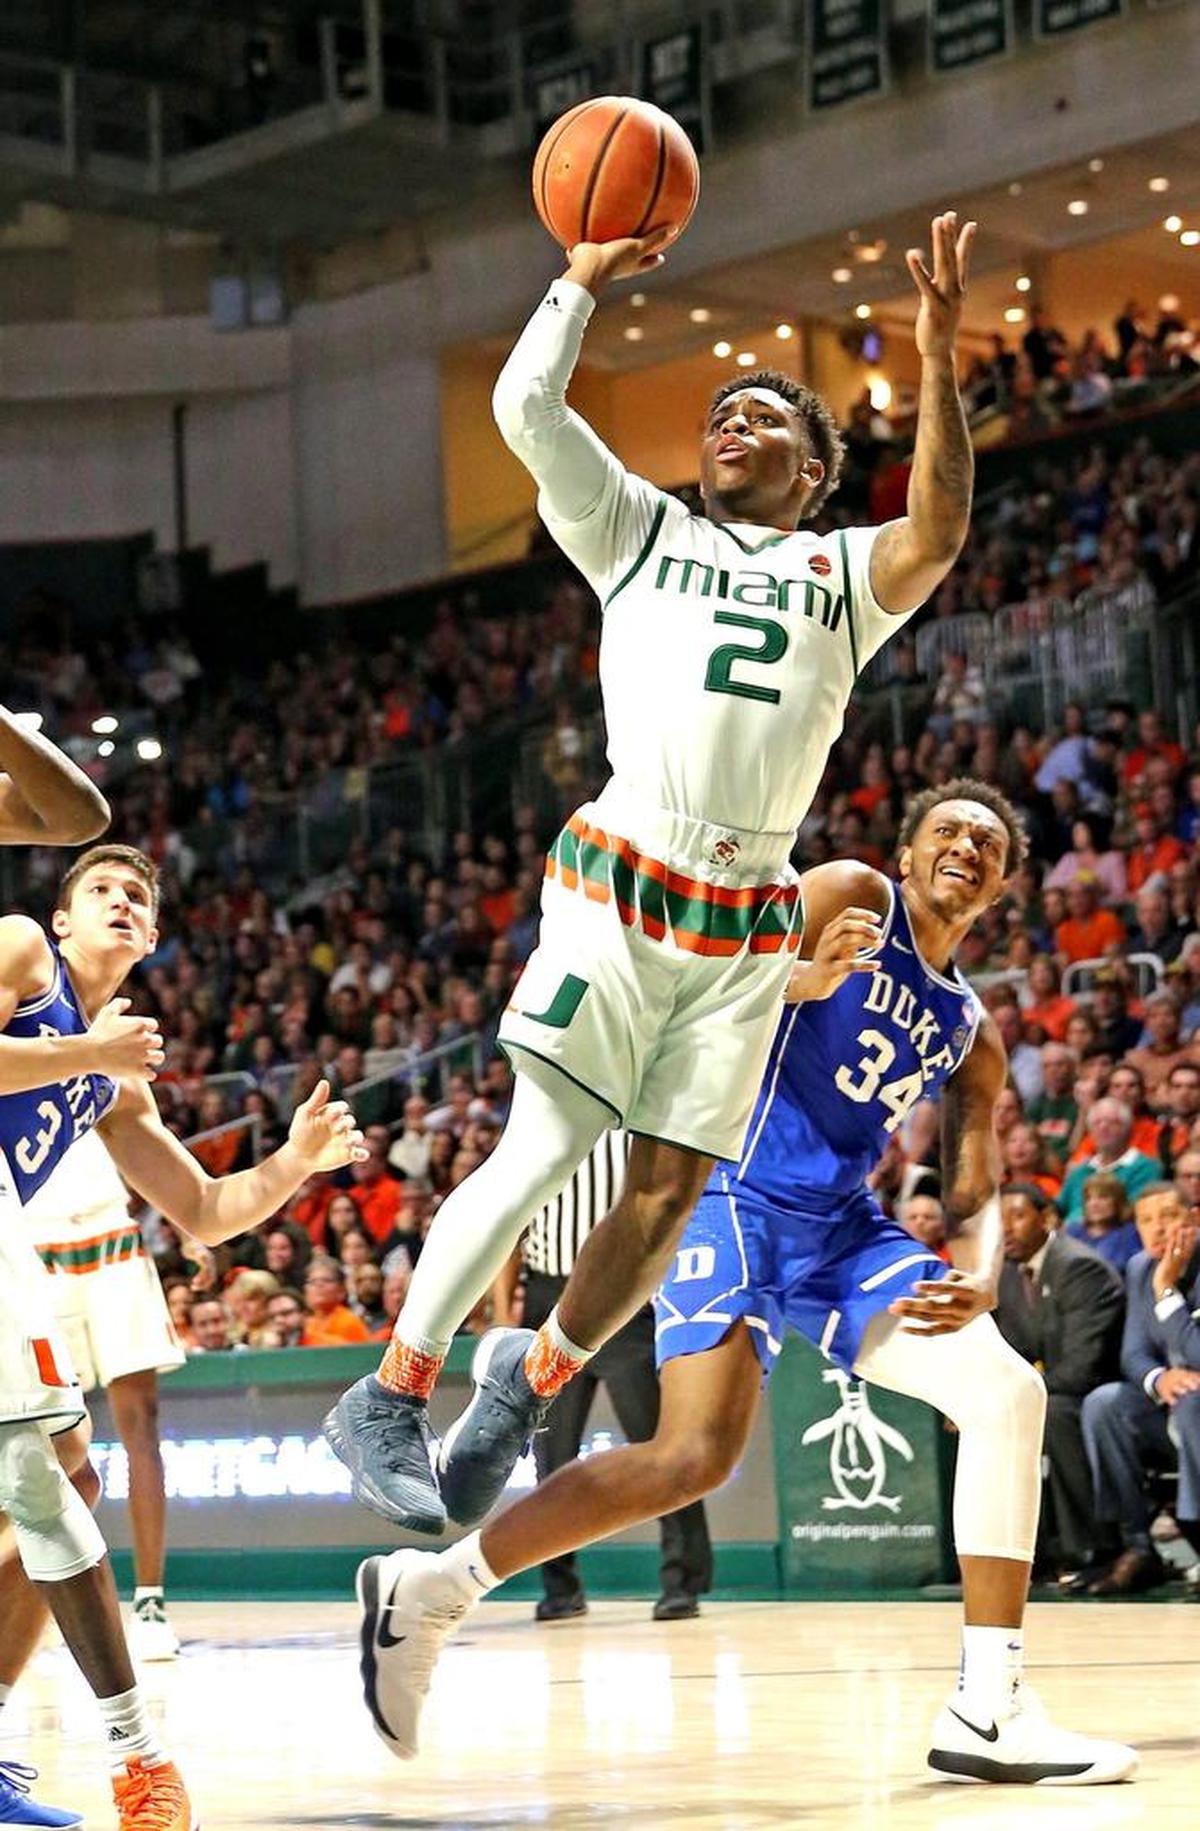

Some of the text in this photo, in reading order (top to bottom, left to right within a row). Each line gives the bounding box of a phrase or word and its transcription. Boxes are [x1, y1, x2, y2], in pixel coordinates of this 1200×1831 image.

[704, 610, 788, 705] 2
[864, 971, 954, 1082] DUKE
[834, 1029, 923, 1133] 34
[15, 1100, 62, 1174] 3
[672, 1246, 716, 1283] D
[791, 1522, 936, 1542] originalpenguin.com
